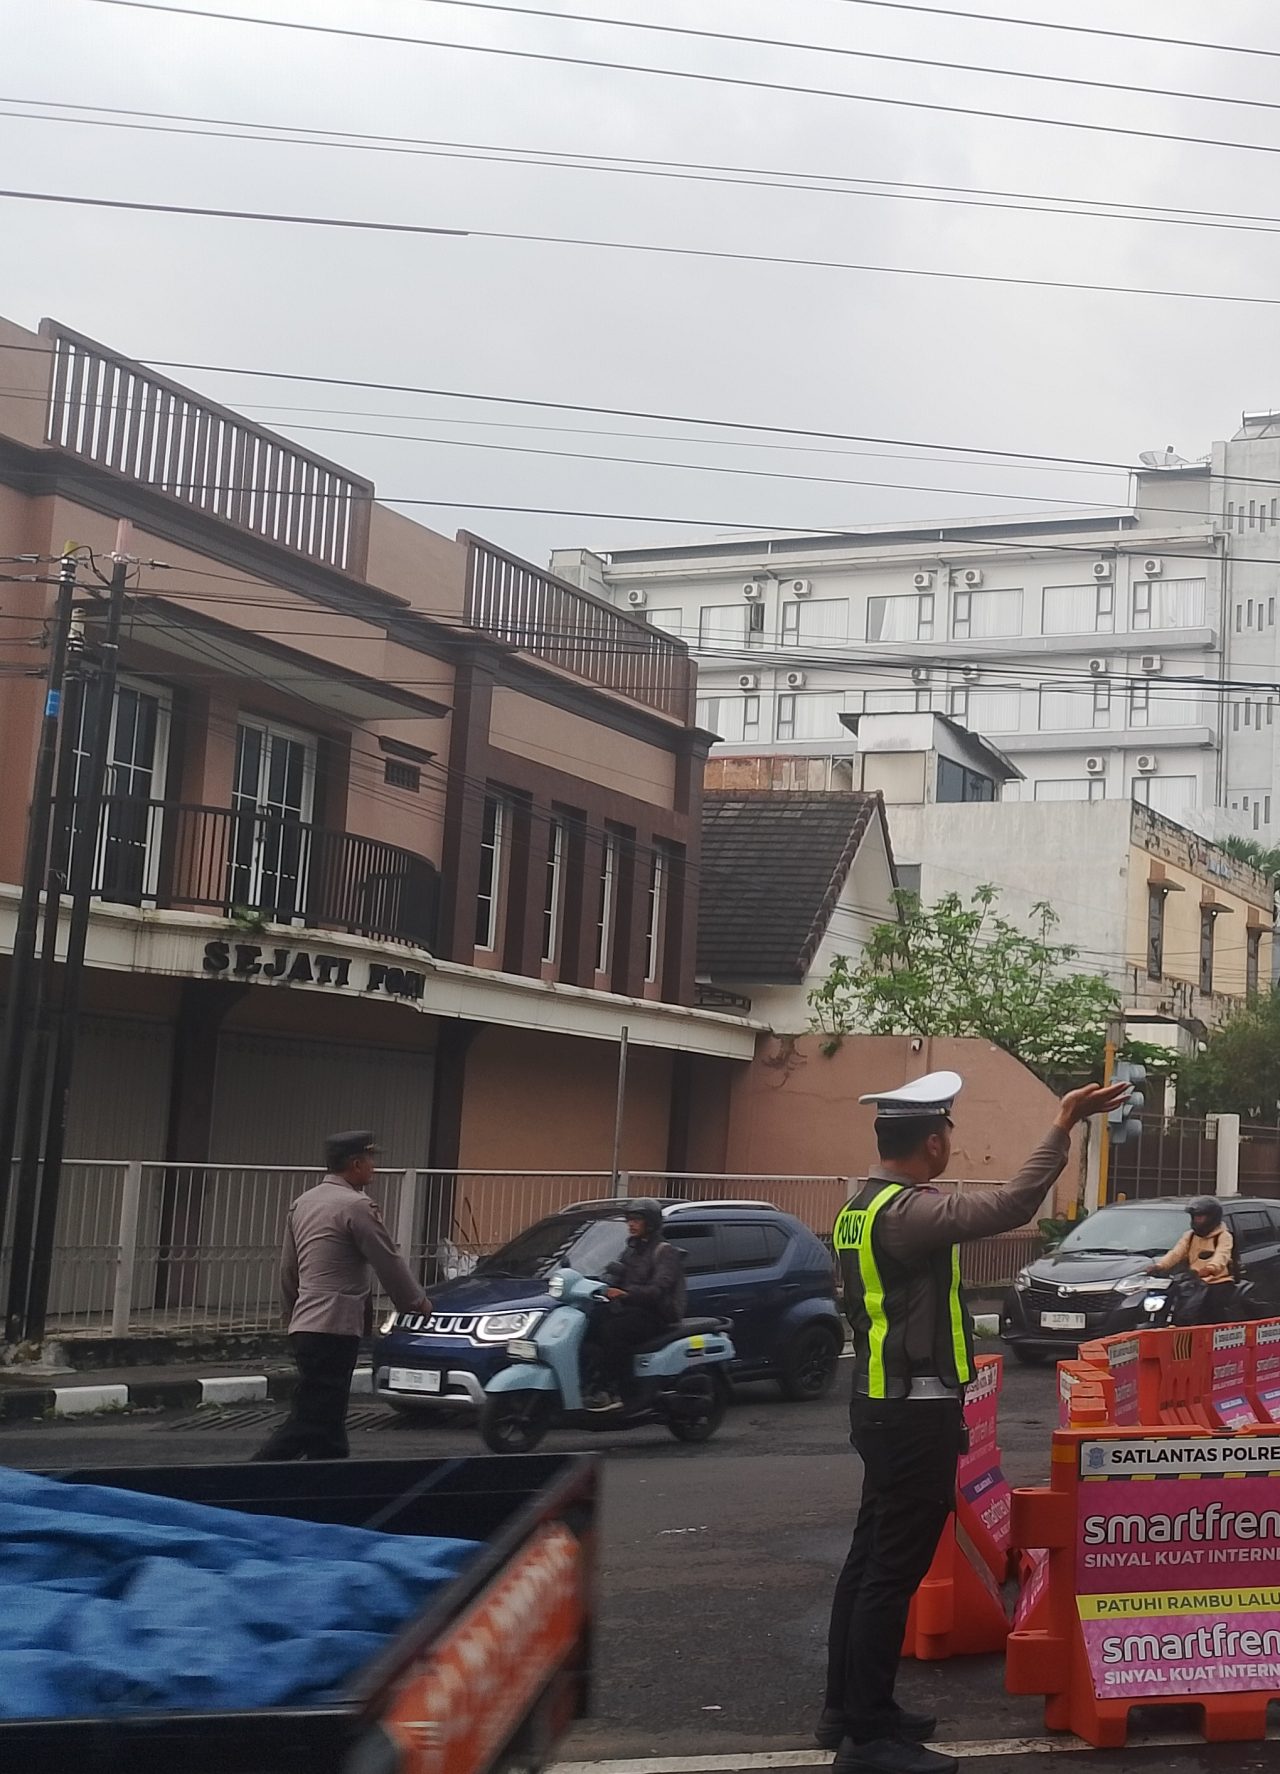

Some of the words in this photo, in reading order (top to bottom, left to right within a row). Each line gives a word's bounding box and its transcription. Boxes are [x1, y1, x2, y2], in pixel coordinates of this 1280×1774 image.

[203, 941, 352, 986] SEJATI
[837, 1214, 867, 1246] POLISI
[1111, 1446, 1218, 1464] SATLANTAS
[1084, 1553, 1151, 1568] SINYAL
[1155, 1551, 1202, 1565] KUAT
[1096, 1597, 1162, 1613] PATUHI
[1168, 1594, 1233, 1609] RAMBU
[1239, 1592, 1280, 1607] LALU
[1104, 1670, 1166, 1685] SINYAL
[1170, 1666, 1215, 1681] KUAT
